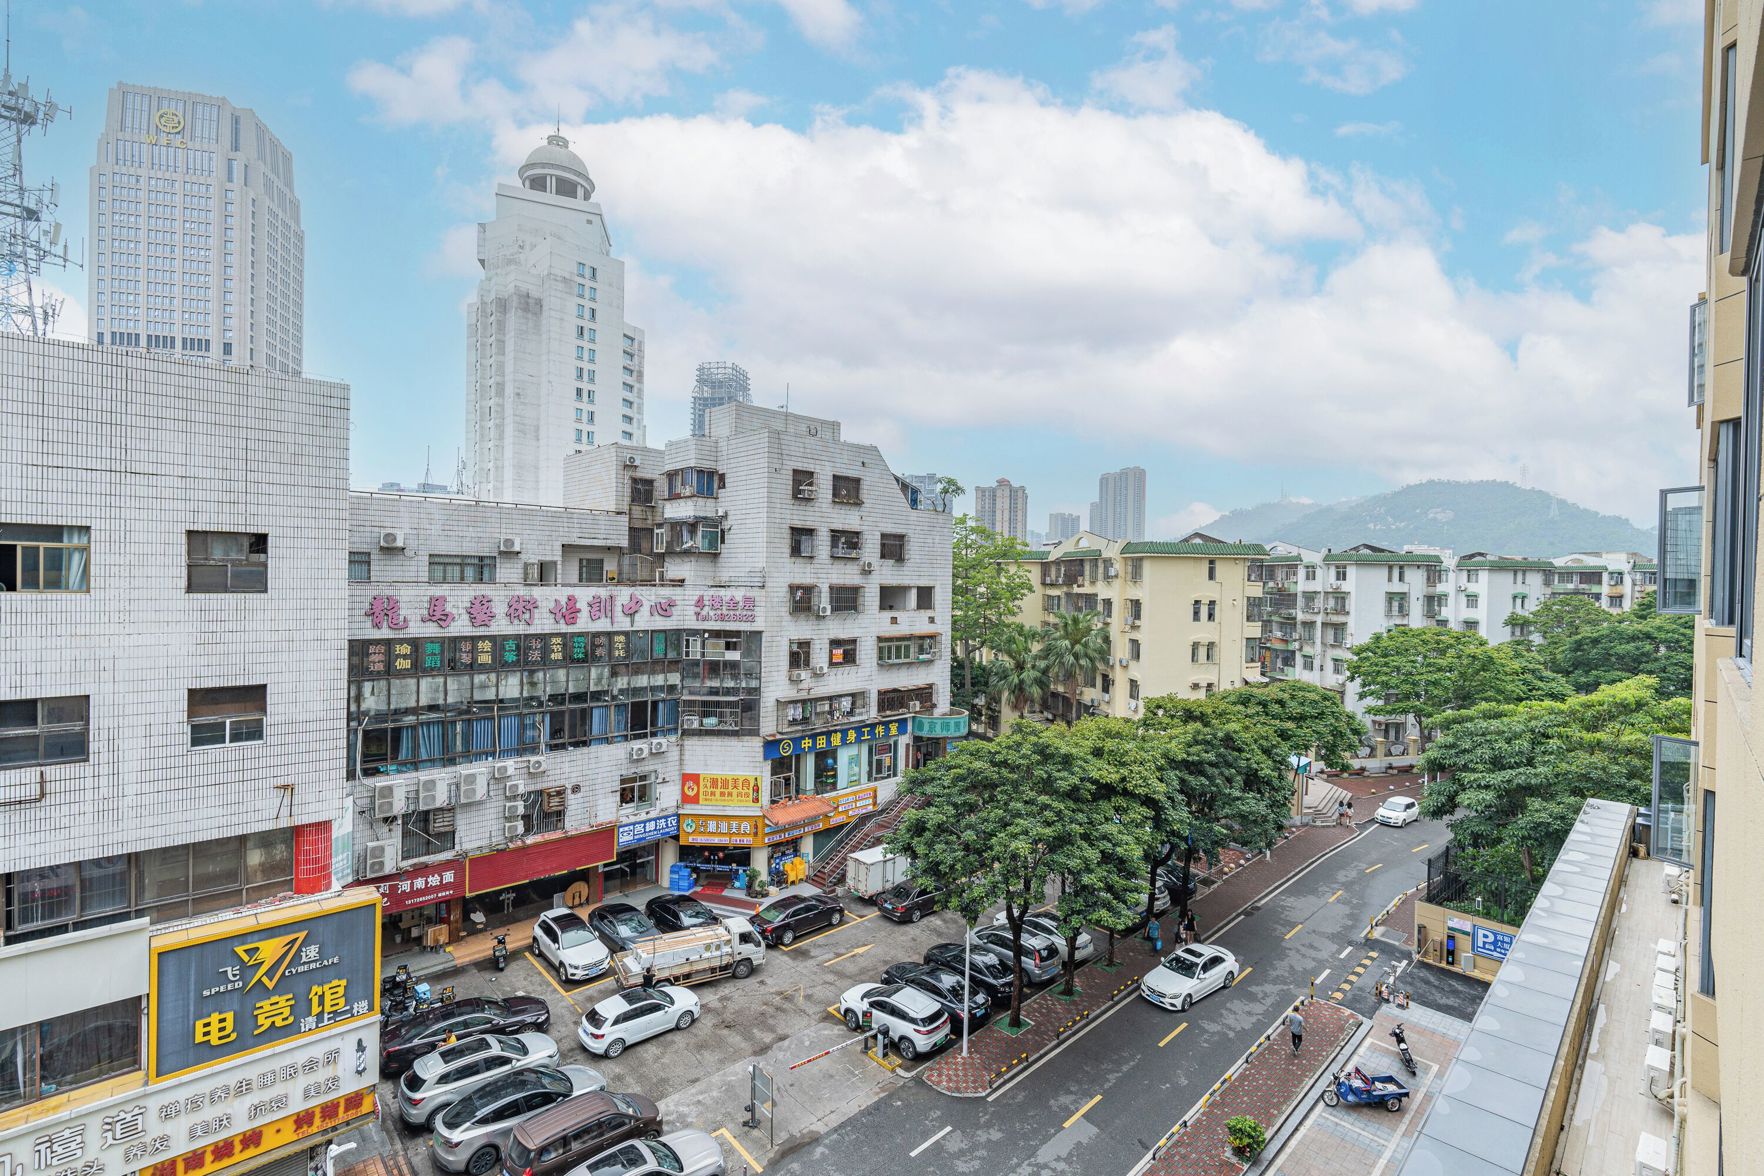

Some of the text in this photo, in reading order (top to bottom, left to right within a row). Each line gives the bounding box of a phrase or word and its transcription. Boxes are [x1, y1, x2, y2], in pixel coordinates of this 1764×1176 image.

[144, 133, 188, 149] WFC
[394, 643, 411, 669] 瑜伽
[425, 642, 442, 668] 舞蹈
[477, 640, 492, 664] 绘画
[503, 639, 518, 663] 古筝
[528, 637, 542, 661] 书法
[801, 722, 898, 752] 中田健身工作室
[709, 777, 751, 790] 潮汕美食
[707, 820, 750, 834] 潮汕美食
[398, 870, 455, 893] 河南烩面
[1477, 928, 1495, 947] P
[219, 944, 320, 981] 飞 速
[202, 955, 340, 997] SPEED CYBERCAFÉ
[194, 977, 348, 1046] 电竞馆
[299, 1000, 369, 1033] 请上二楼
[159, 1047, 341, 1121] 禅疗养生睡眠会所
[124, 1133, 171, 1164] 养发
[188, 1113, 232, 1141] 美肤
[248, 1094, 289, 1121] 抗衰
[303, 1075, 342, 1100] 美发
